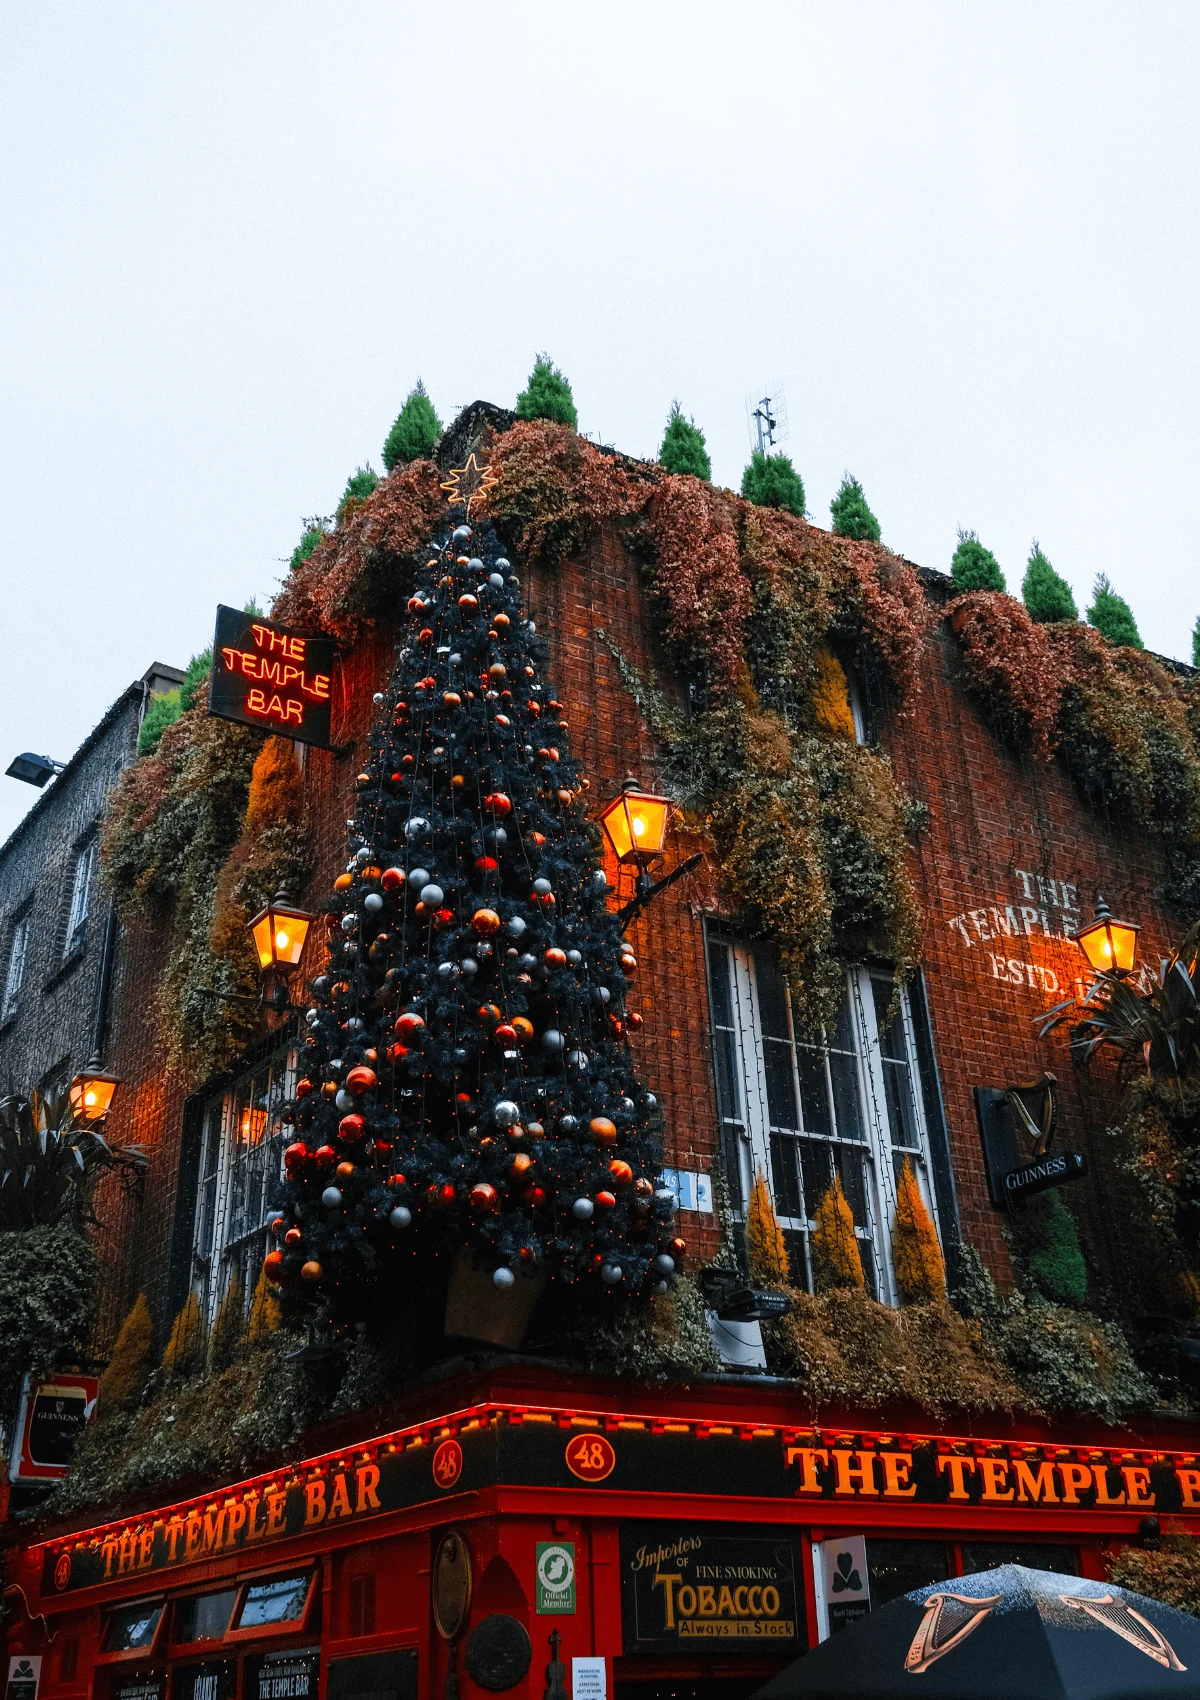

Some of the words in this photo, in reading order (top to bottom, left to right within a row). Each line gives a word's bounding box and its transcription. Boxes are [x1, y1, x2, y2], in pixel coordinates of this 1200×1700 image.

[252, 624, 305, 661] THE
[222, 647, 330, 698] TEMPLE
[248, 689, 303, 724] BAR
[1015, 869, 1081, 913] THE
[947, 905, 1079, 948] TEMPLE
[1006, 1156, 1067, 1190] GUINNESS
[697, 1183, 707, 1202] 2
[37, 1411, 79, 1422] GUINNESS
[437, 1449, 457, 1480] 48
[574, 1440, 605, 1469] 48
[787, 1447, 917, 1497] THE
[938, 1455, 1156, 1507] TEMPLE
[100, 1529, 155, 1579] THE
[164, 1491, 288, 1562] TEMPLE
[304, 1464, 382, 1526] BAR
[631, 1534, 702, 1572] Importers
[676, 1557, 689, 1567] OF
[57, 1561, 68, 1585] 48
[696, 1565, 723, 1579] FINE
[725, 1566, 777, 1580] SMOKING
[652, 1573, 781, 1631] TOBACCO
[680, 1621, 730, 1637] Always
[736, 1621, 749, 1635] in
[754, 1620, 793, 1635] Stock
[259, 1680, 271, 1699] THE
[272, 1677, 294, 1697] TEMPLE
[295, 1675, 309, 1695] BAR
